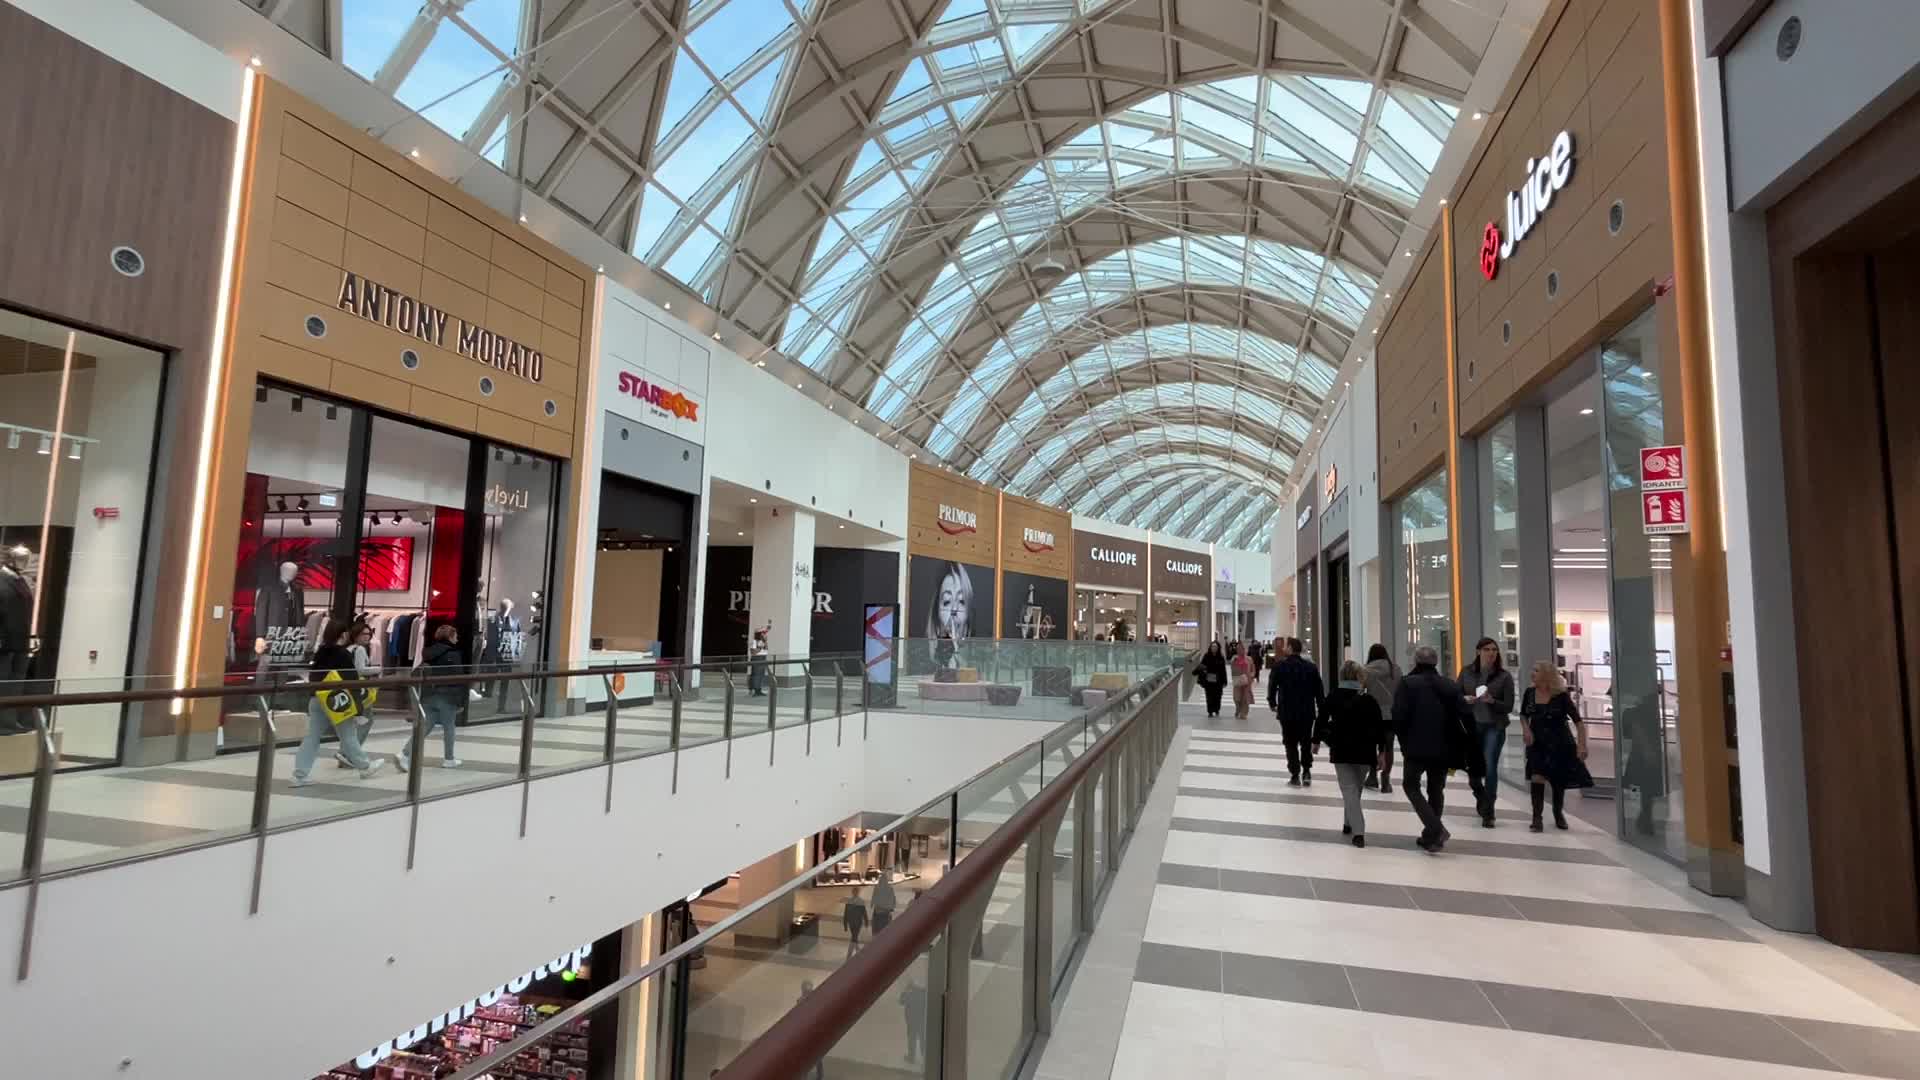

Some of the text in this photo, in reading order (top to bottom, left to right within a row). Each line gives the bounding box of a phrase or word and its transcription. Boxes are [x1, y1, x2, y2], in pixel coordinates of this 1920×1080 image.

[1500, 130, 1575, 259] Juice
[336, 271, 543, 384] ANTONY MORATO
[618, 371, 699, 423] STARBOX
[1642, 480, 1683, 489] IDRANTE
[938, 503, 977, 529] PRIMOR
[1090, 547, 1137, 566] CALLIOPE
[1165, 559, 1203, 576] CALLIOPE
